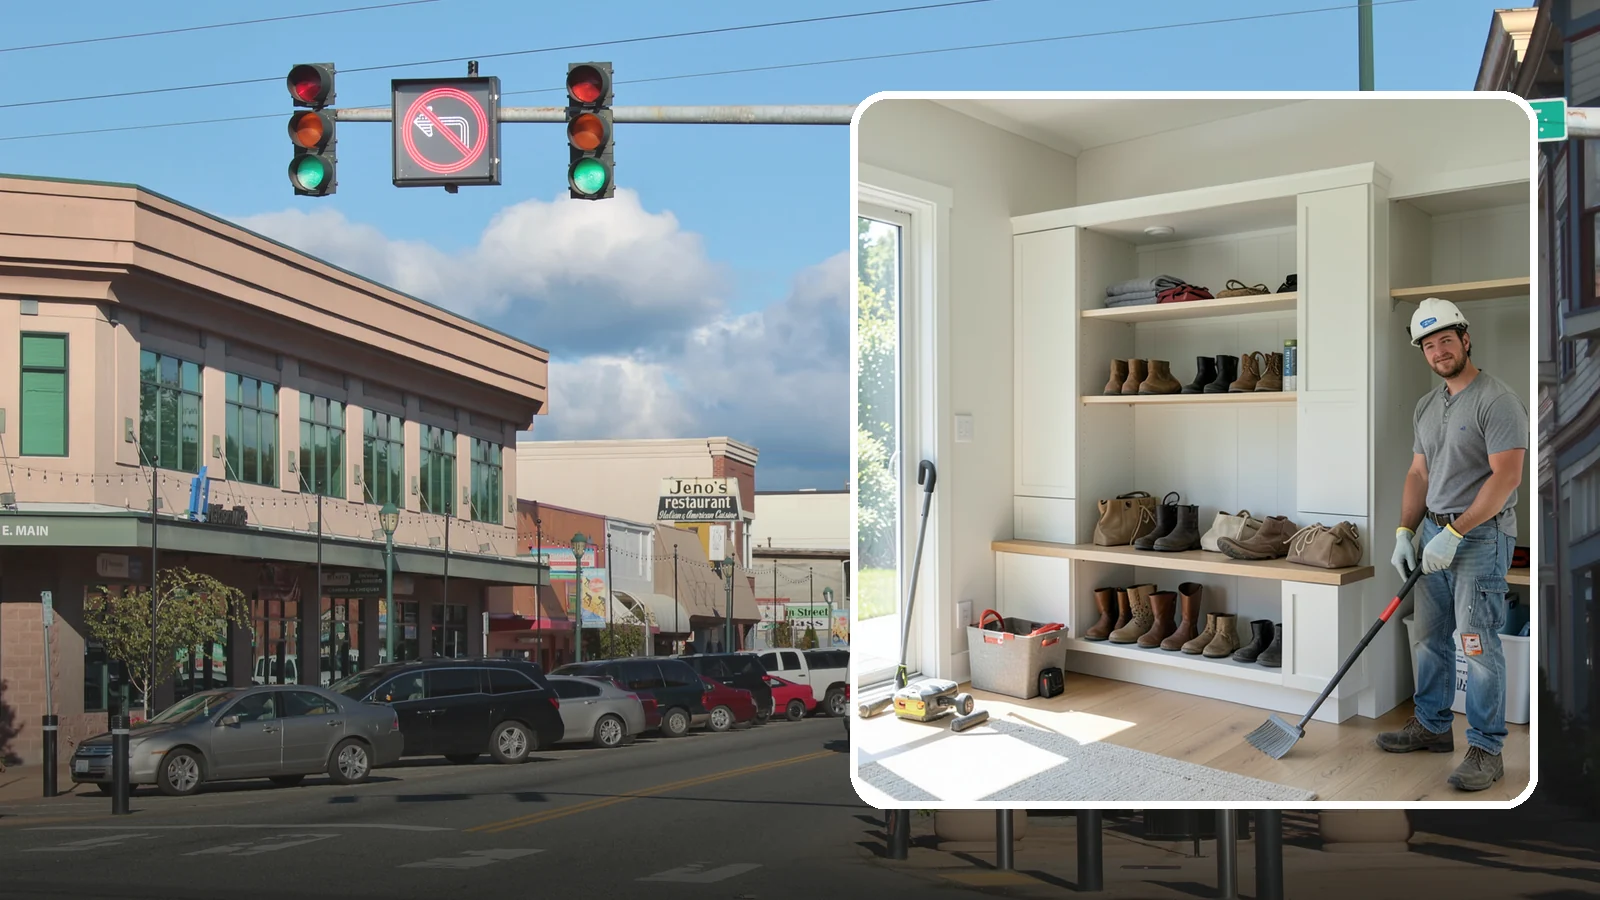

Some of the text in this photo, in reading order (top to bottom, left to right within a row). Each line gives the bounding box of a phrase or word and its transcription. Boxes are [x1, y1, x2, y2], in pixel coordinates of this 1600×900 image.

[669, 480, 728, 495] Jeno's
[665, 496, 732, 509] restaurant
[659, 509, 682, 519] Italian
[686, 509, 715, 519] American
[715, 509, 738, 519] Cuisine
[2, 525, 49, 536] E. MAIN
[797, 606, 828, 616] Street
